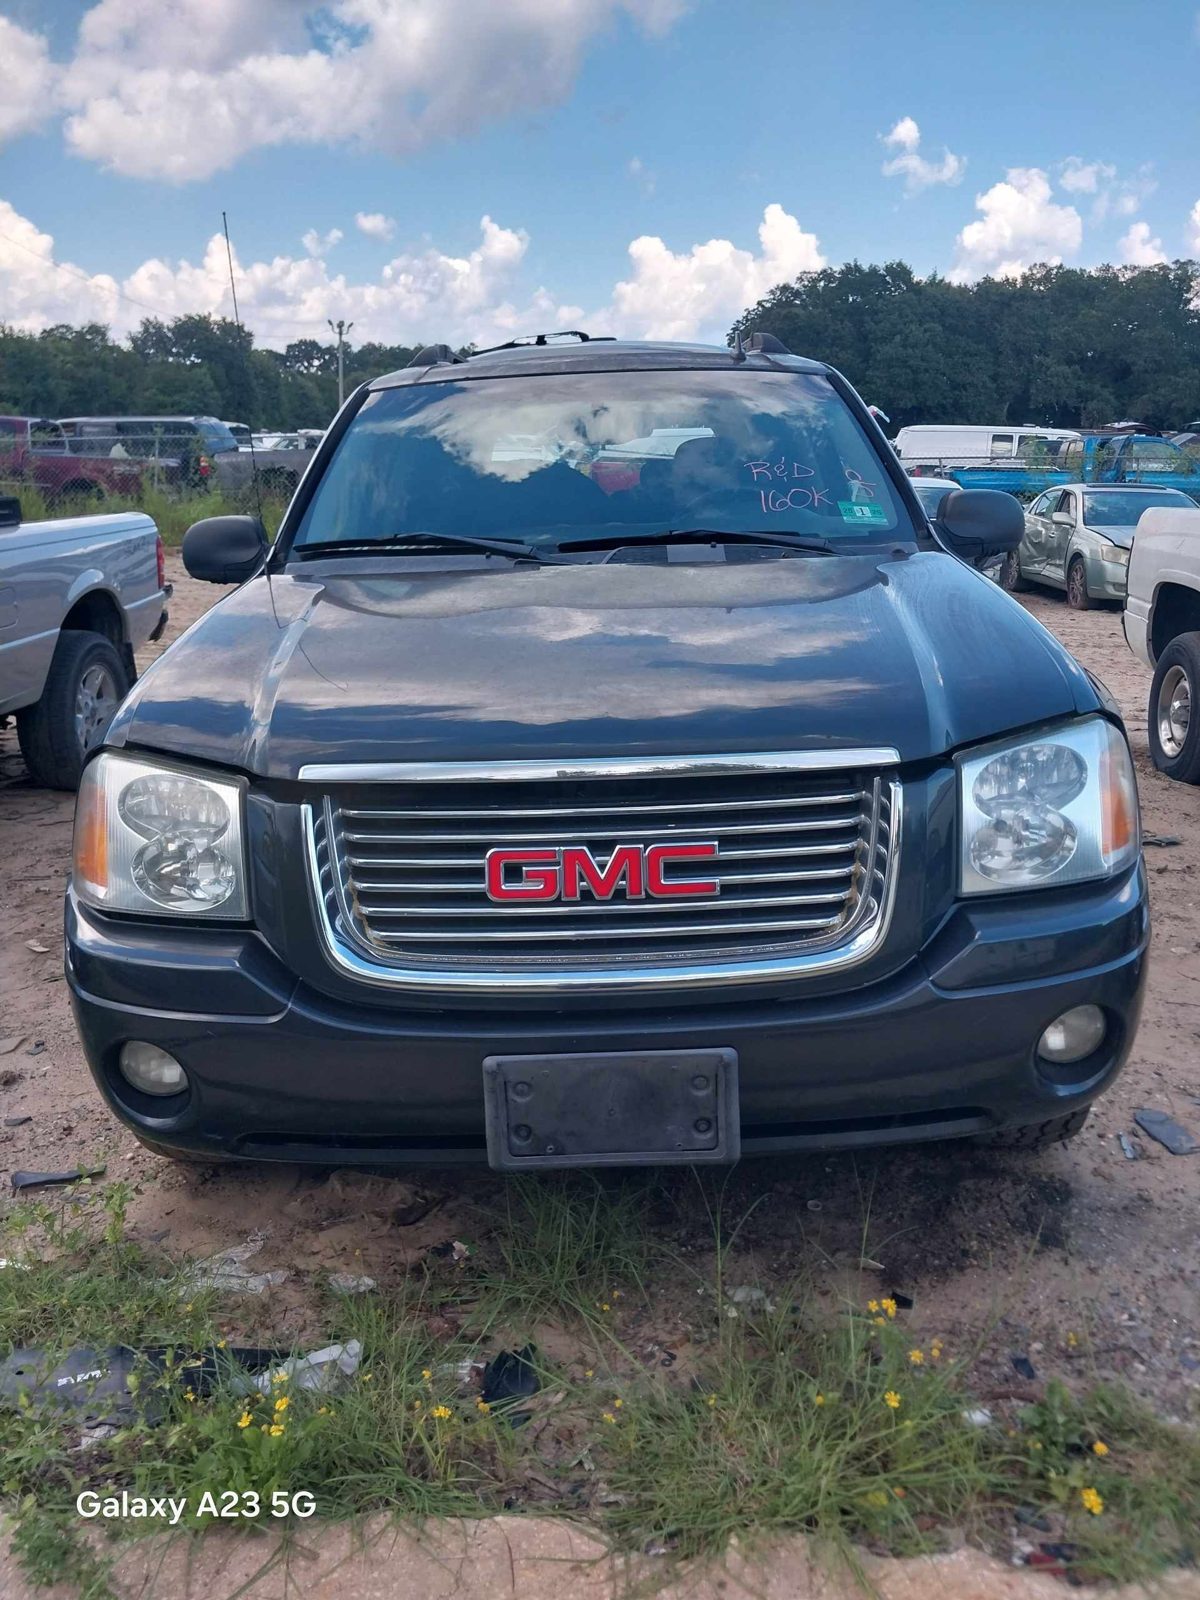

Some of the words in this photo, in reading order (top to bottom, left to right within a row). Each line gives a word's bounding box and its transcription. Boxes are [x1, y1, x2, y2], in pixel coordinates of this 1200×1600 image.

[744, 456, 815, 482] R&D
[760, 486, 834, 513] 160K
[486, 841, 721, 902] GMC
